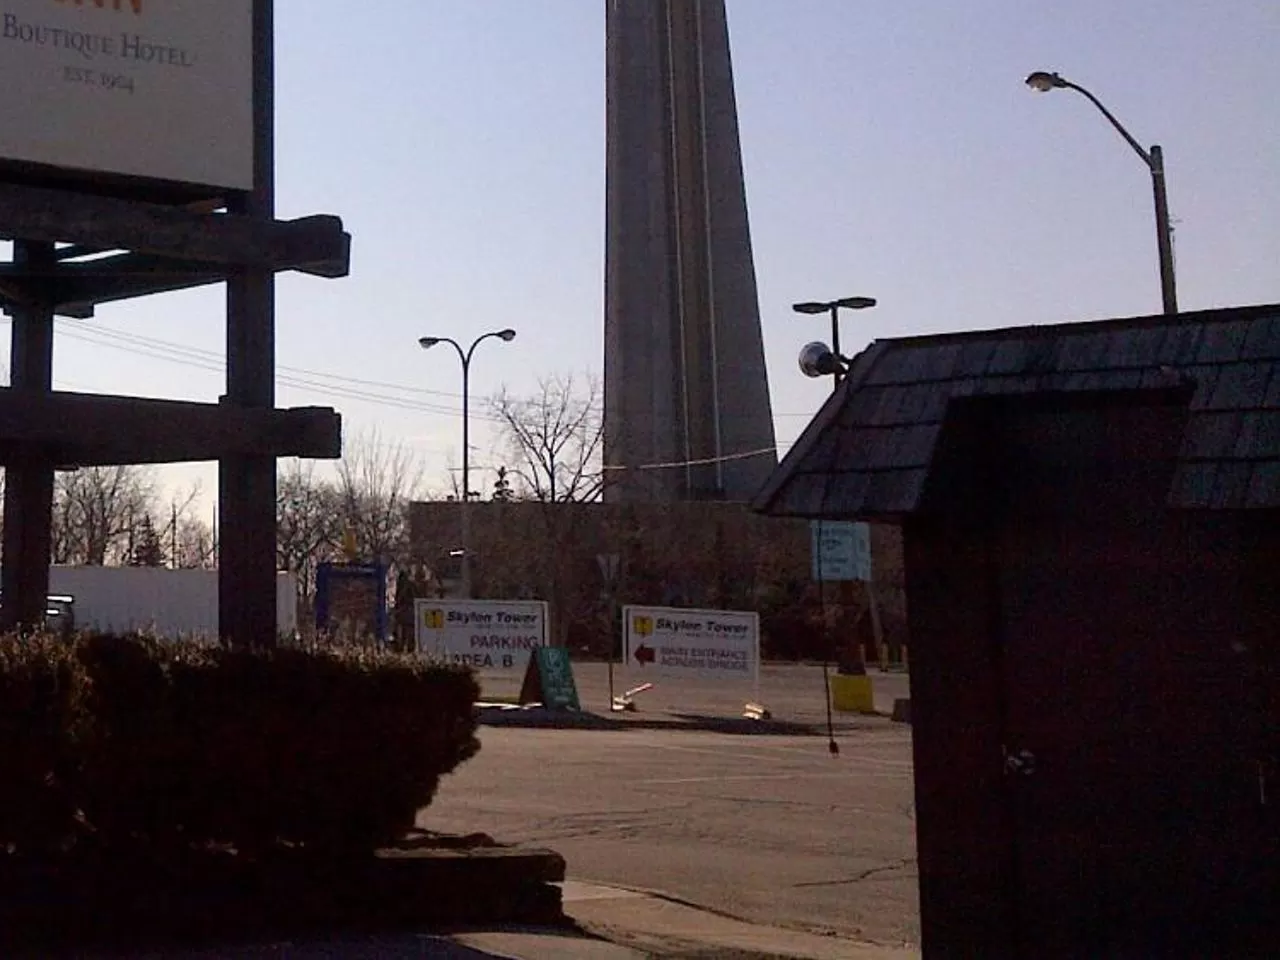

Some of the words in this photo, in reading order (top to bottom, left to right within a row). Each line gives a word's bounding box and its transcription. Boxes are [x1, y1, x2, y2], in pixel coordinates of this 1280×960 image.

[446, 611, 492, 625] Skylon
[496, 611, 538, 625] Tower
[656, 618, 701, 633] Skylon
[706, 620, 749, 633] Tower
[470, 634, 539, 651] PARKING
[502, 654, 513, 668] B
